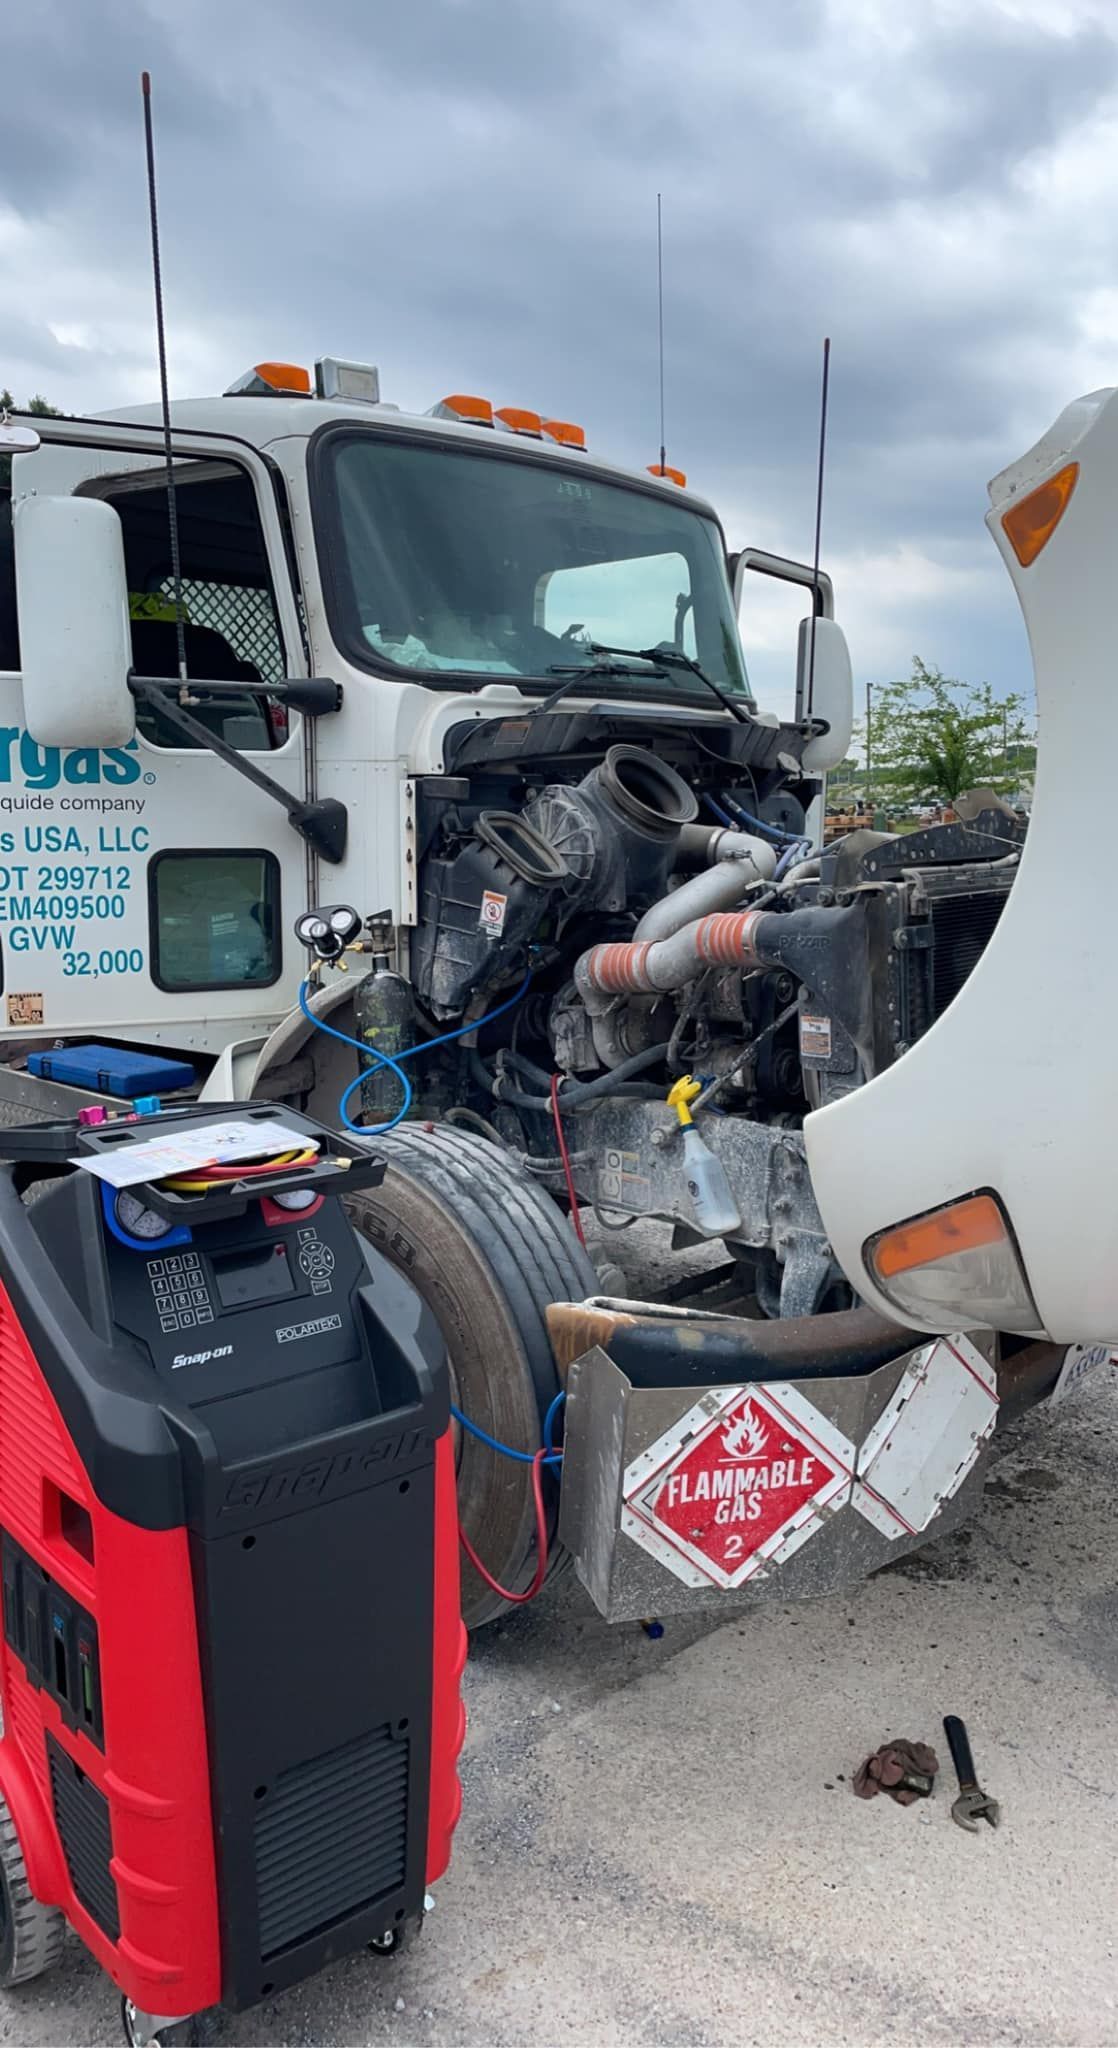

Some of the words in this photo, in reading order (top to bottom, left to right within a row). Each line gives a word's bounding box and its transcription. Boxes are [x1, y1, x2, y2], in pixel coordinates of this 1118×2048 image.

[0, 794, 54, 813] quide
[60, 798, 146, 814] company
[24, 826, 90, 856] USA,
[99, 826, 150, 852] LLC
[38, 866, 131, 890] 299712
[9, 925, 76, 951] GVW
[62, 949, 144, 978] 32,000
[184, 1314, 191, 1324] 0
[171, 1344, 233, 1369] Snap-on
[668, 1457, 815, 1508] FLAMMABLE
[714, 1492, 762, 1525] GAS
[723, 1535, 743, 1559] 2
